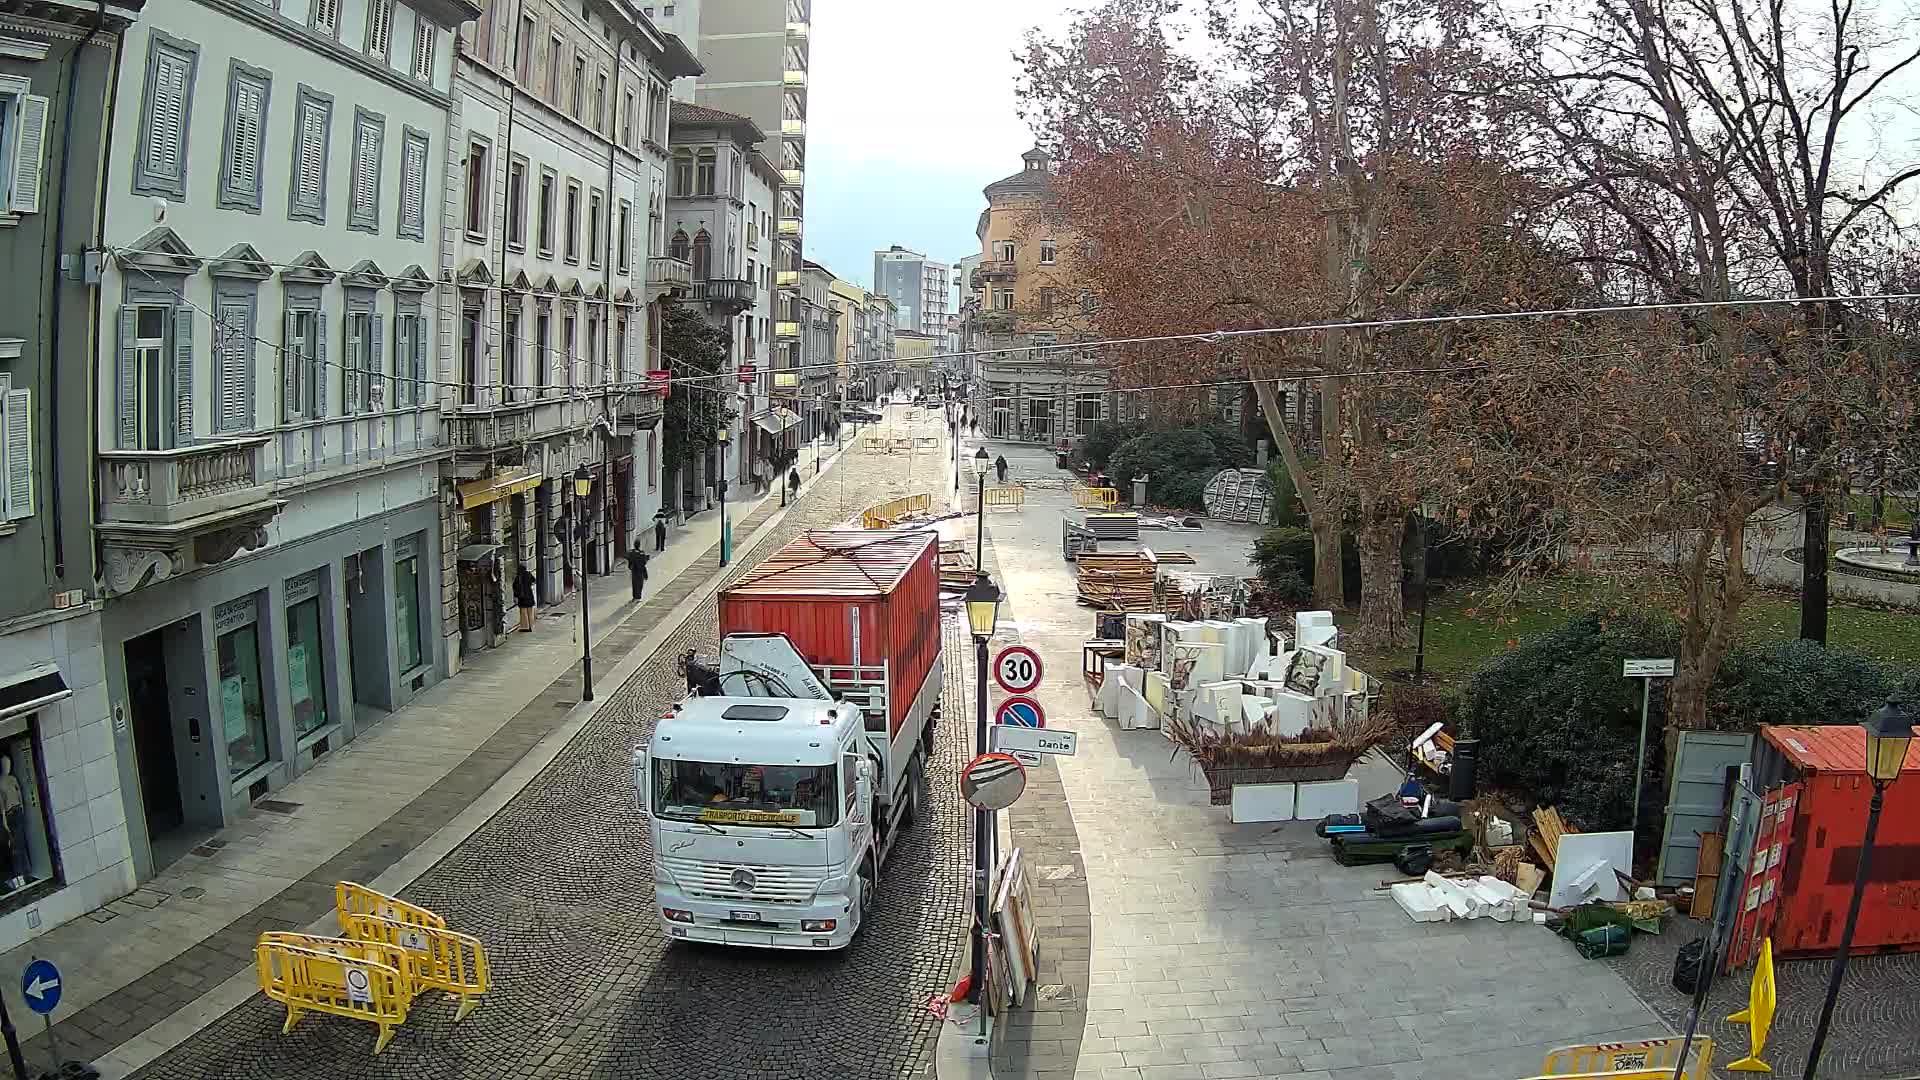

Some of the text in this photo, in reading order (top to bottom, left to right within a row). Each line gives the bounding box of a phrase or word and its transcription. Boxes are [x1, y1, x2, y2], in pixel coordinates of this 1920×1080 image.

[1005, 659, 1032, 681] 30
[1039, 739, 1070, 749] Dante
[706, 810, 745, 821] TRASPORTO
